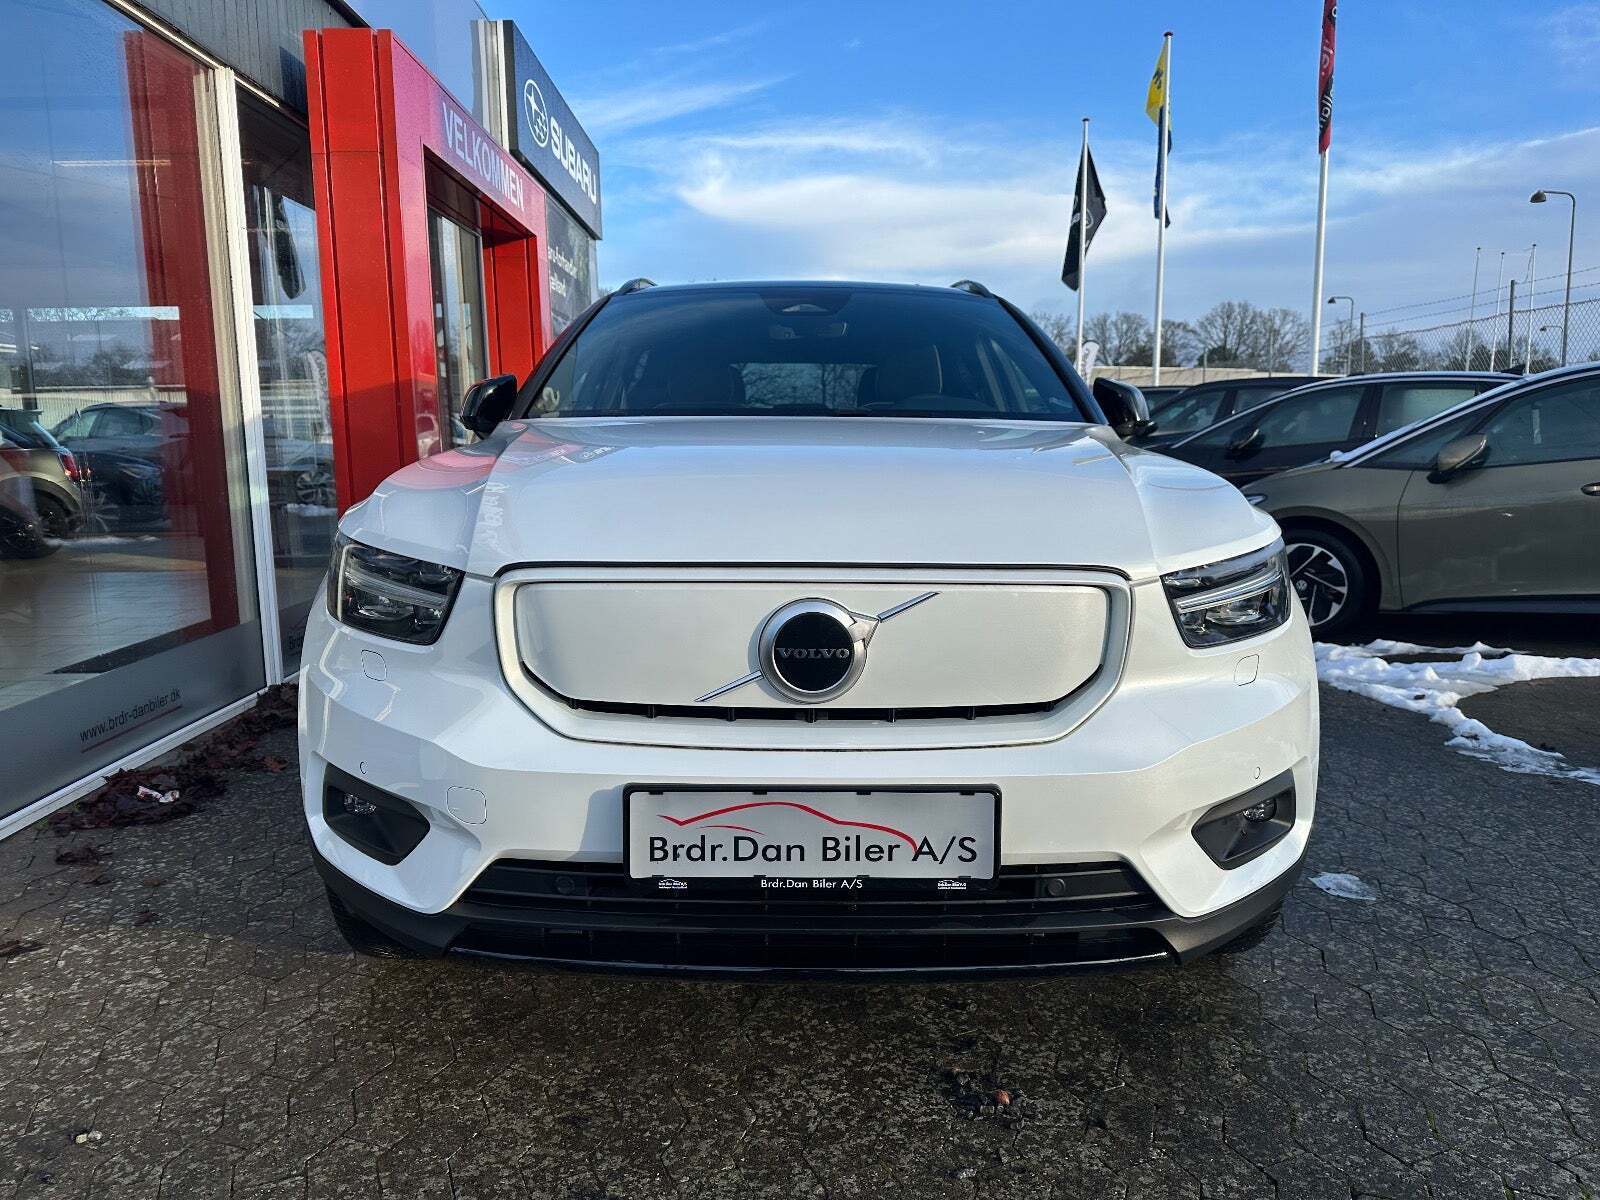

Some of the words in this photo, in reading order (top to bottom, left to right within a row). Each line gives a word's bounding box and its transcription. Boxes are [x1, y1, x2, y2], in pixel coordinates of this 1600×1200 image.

[442, 101, 525, 212] VELKOMMEN
[550, 116, 597, 205] SUBARU
[776, 647, 850, 659] VOLVO
[79, 687, 182, 744] www.brdr-danbiler.dk
[649, 835, 805, 862] Brdr.Dan
[821, 835, 901, 862] Biler
[911, 836, 977, 865] A/S
[760, 879, 808, 889] Brdr.Dan
[812, 879, 837, 889] Biler
[840, 879, 863, 890] A/S
